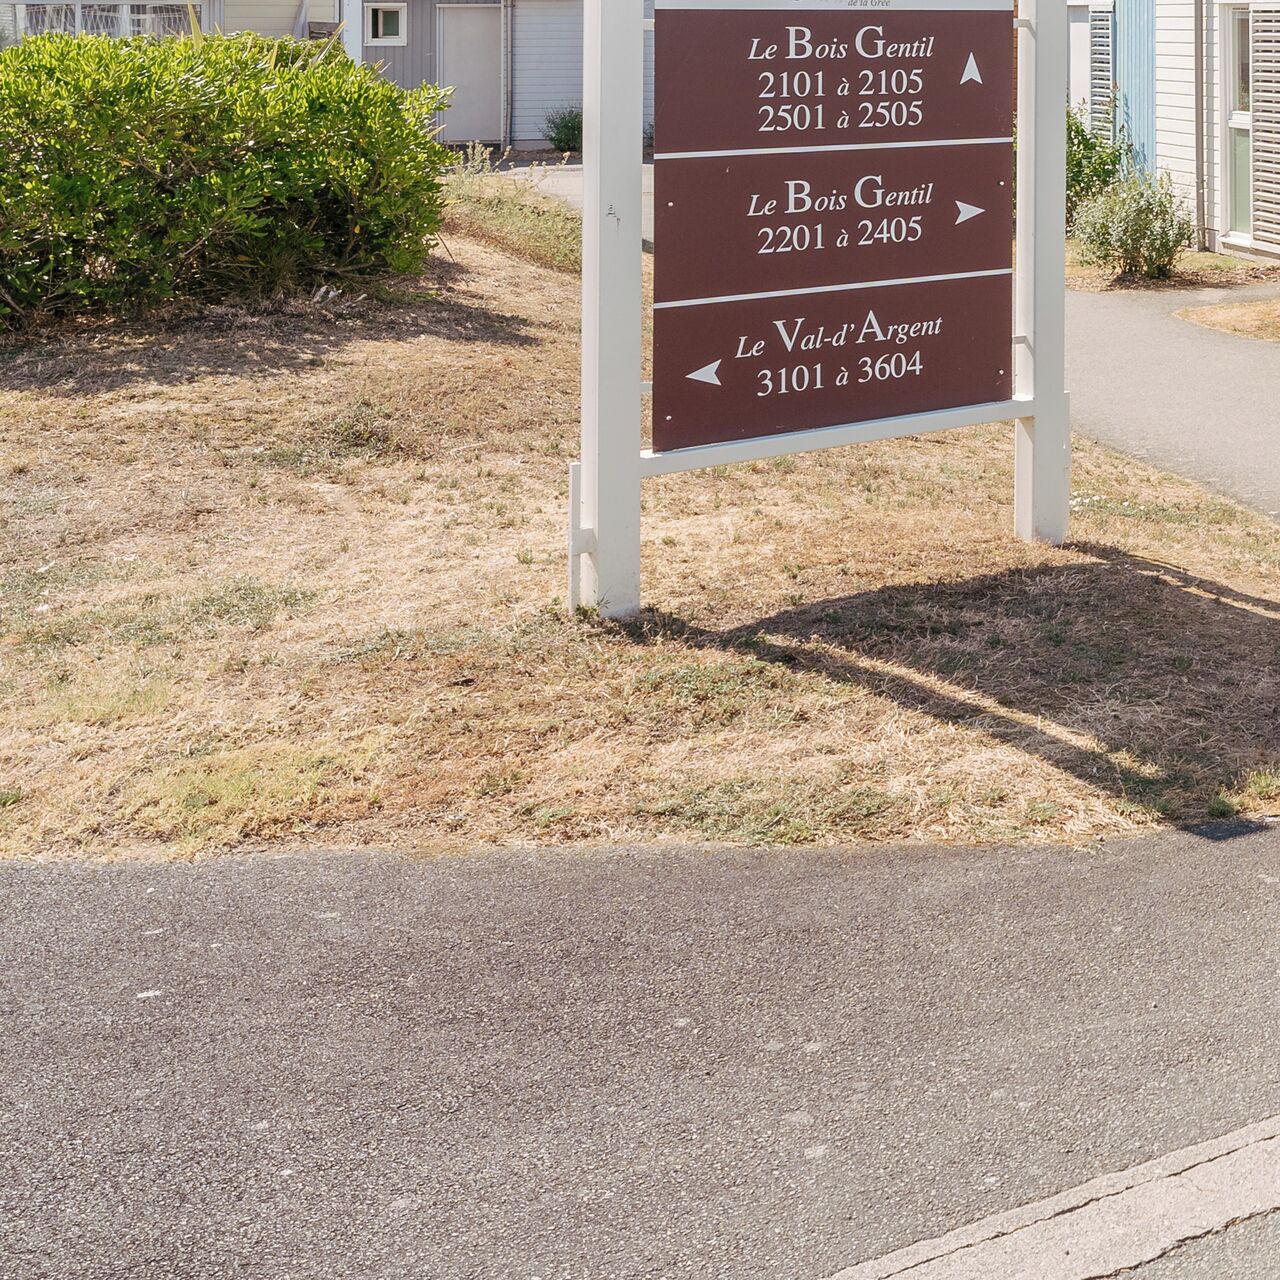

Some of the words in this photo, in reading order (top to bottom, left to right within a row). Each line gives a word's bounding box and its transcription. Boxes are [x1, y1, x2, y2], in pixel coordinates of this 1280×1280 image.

[747, 38, 777, 60] Le
[784, 26, 848, 59] Bois
[855, 25, 934, 59] Gentil
[758, 70, 826, 98] 2101
[836, 77, 849, 96] à
[858, 68, 923, 96] 2105
[758, 103, 826, 132] 2501
[836, 110, 849, 129] à
[858, 100, 923, 128] 2505
[746, 194, 777, 217] Le
[784, 180, 848, 214] Bois
[854, 175, 934, 208] Gentil
[757, 223, 825, 254] 2201
[836, 229, 849, 247] à
[857, 215, 922, 246] 2405
[734, 335, 765, 359] Le
[772, 309, 943, 353] Val-d'Argent
[756, 363, 825, 397] 3101
[835, 366, 849, 386] à
[858, 350, 923, 383] 3604
